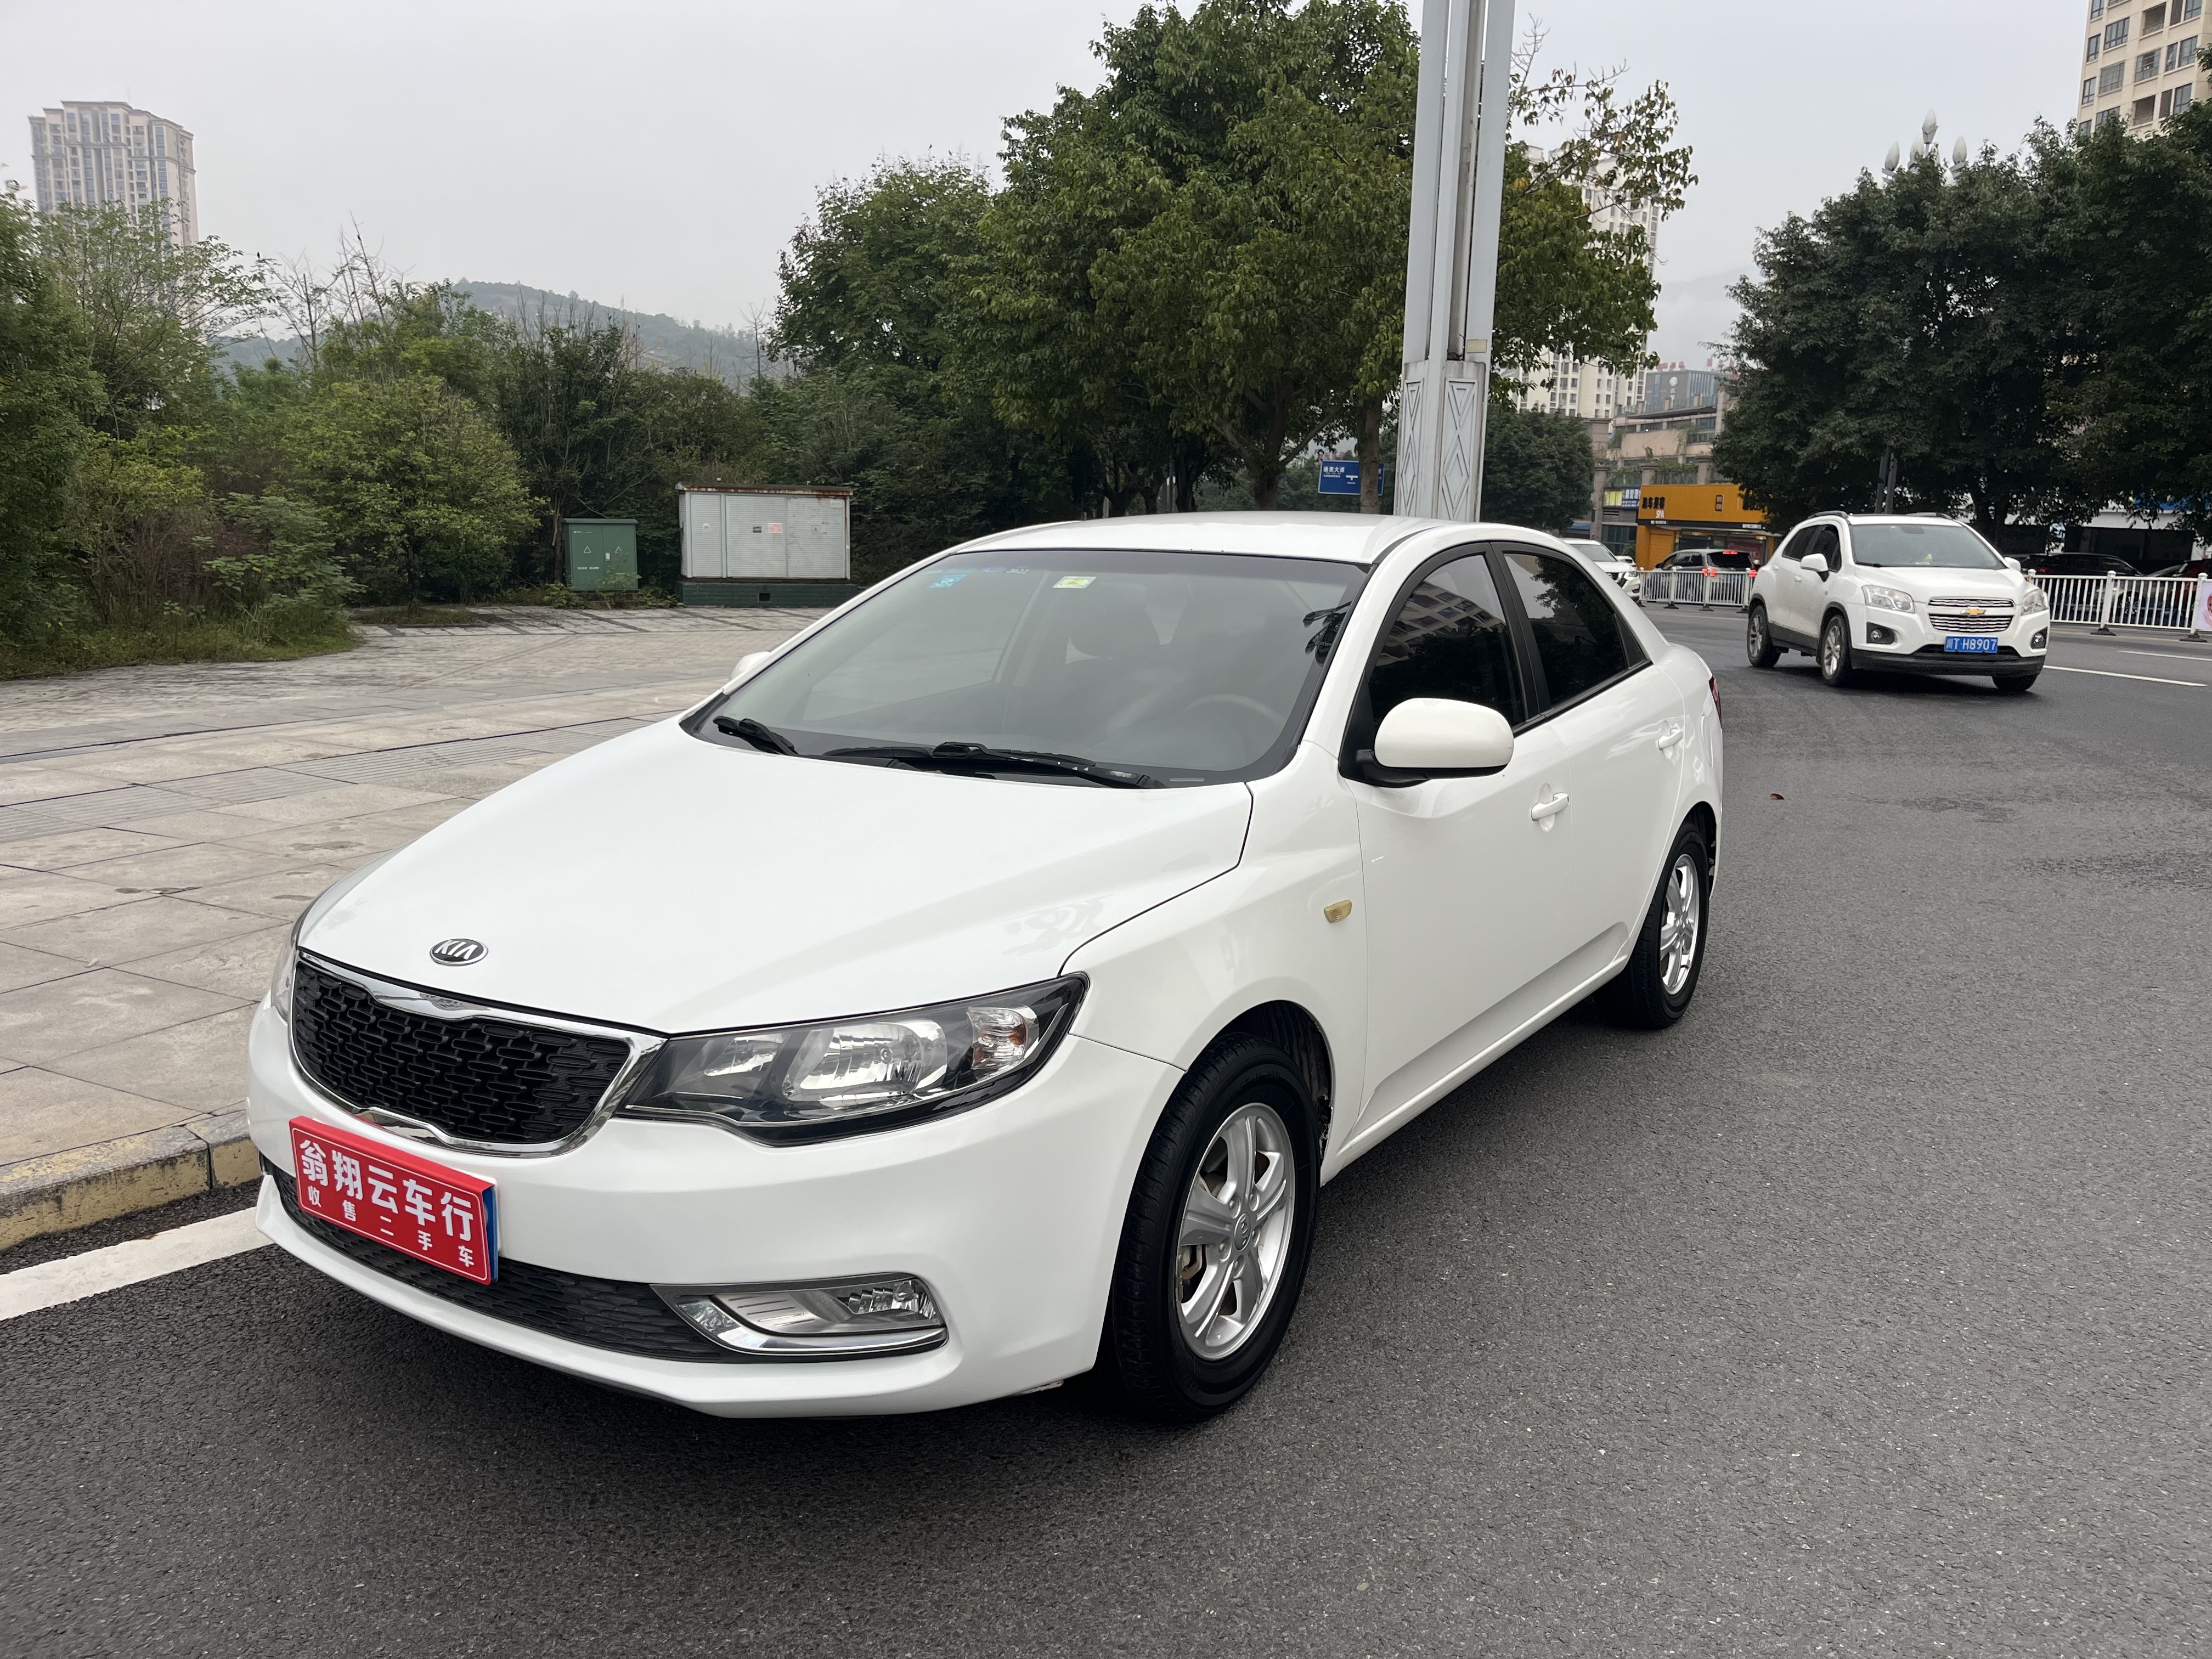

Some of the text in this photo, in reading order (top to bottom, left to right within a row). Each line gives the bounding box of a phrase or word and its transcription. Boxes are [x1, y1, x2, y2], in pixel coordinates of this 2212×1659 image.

[434, 940, 478, 960] KIA
[300, 1139, 474, 1242] 翁翔云车行
[307, 1185, 475, 1268] 收售二手车
